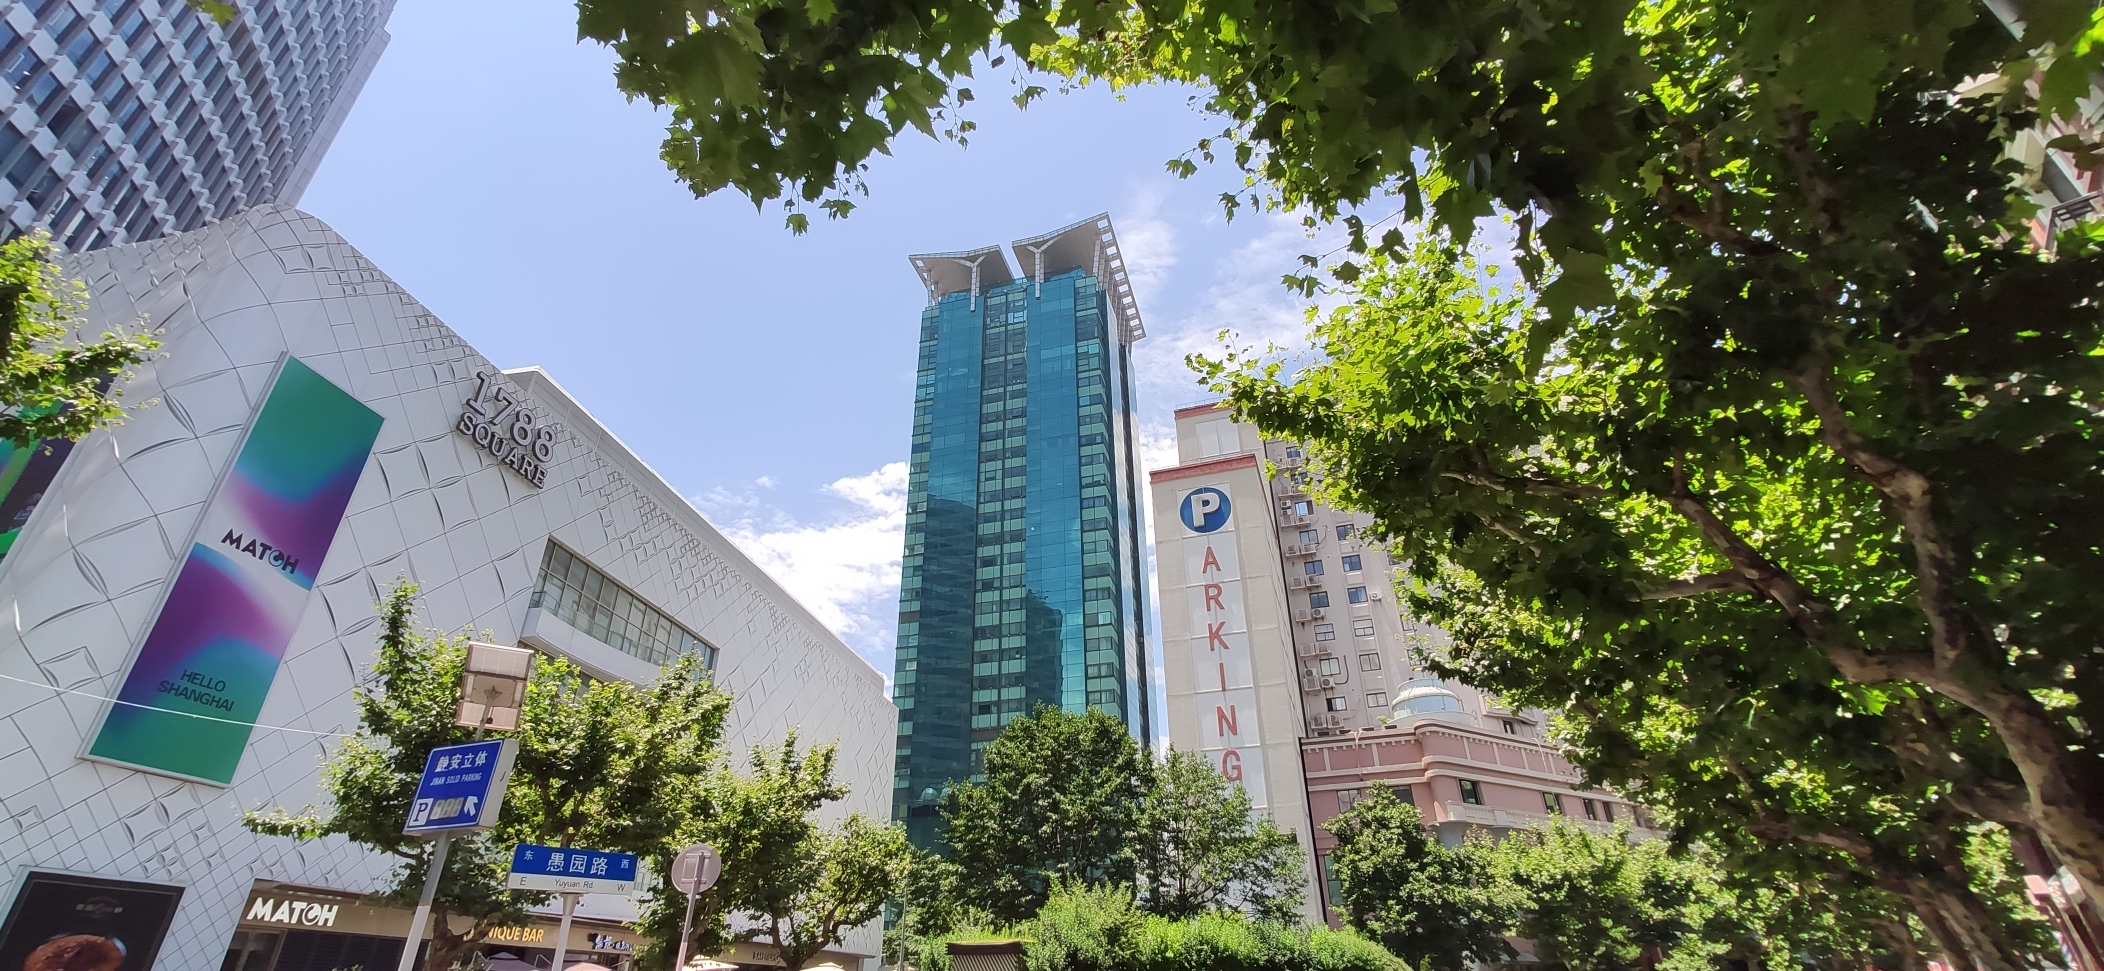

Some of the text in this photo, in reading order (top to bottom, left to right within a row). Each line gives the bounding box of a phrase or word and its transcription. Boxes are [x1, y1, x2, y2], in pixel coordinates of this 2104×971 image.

[465, 371, 557, 463] 1788
[456, 412, 548, 489] SQUARE
[221, 528, 299, 575] MATCH
[180, 669, 226, 692] HELLO
[157, 680, 235, 712] SHANGHAI
[435, 750, 488, 773] 静安立体
[446, 775, 460, 784] SOLID
[461, 772, 482, 783] PARKING
[413, 802, 428, 822] P
[524, 850, 630, 876] 东 愚园路 西
[520, 877, 626, 892] E Yuyuan Rd. W
[246, 897, 339, 927] MATCH
[522, 927, 544, 943] BAR
